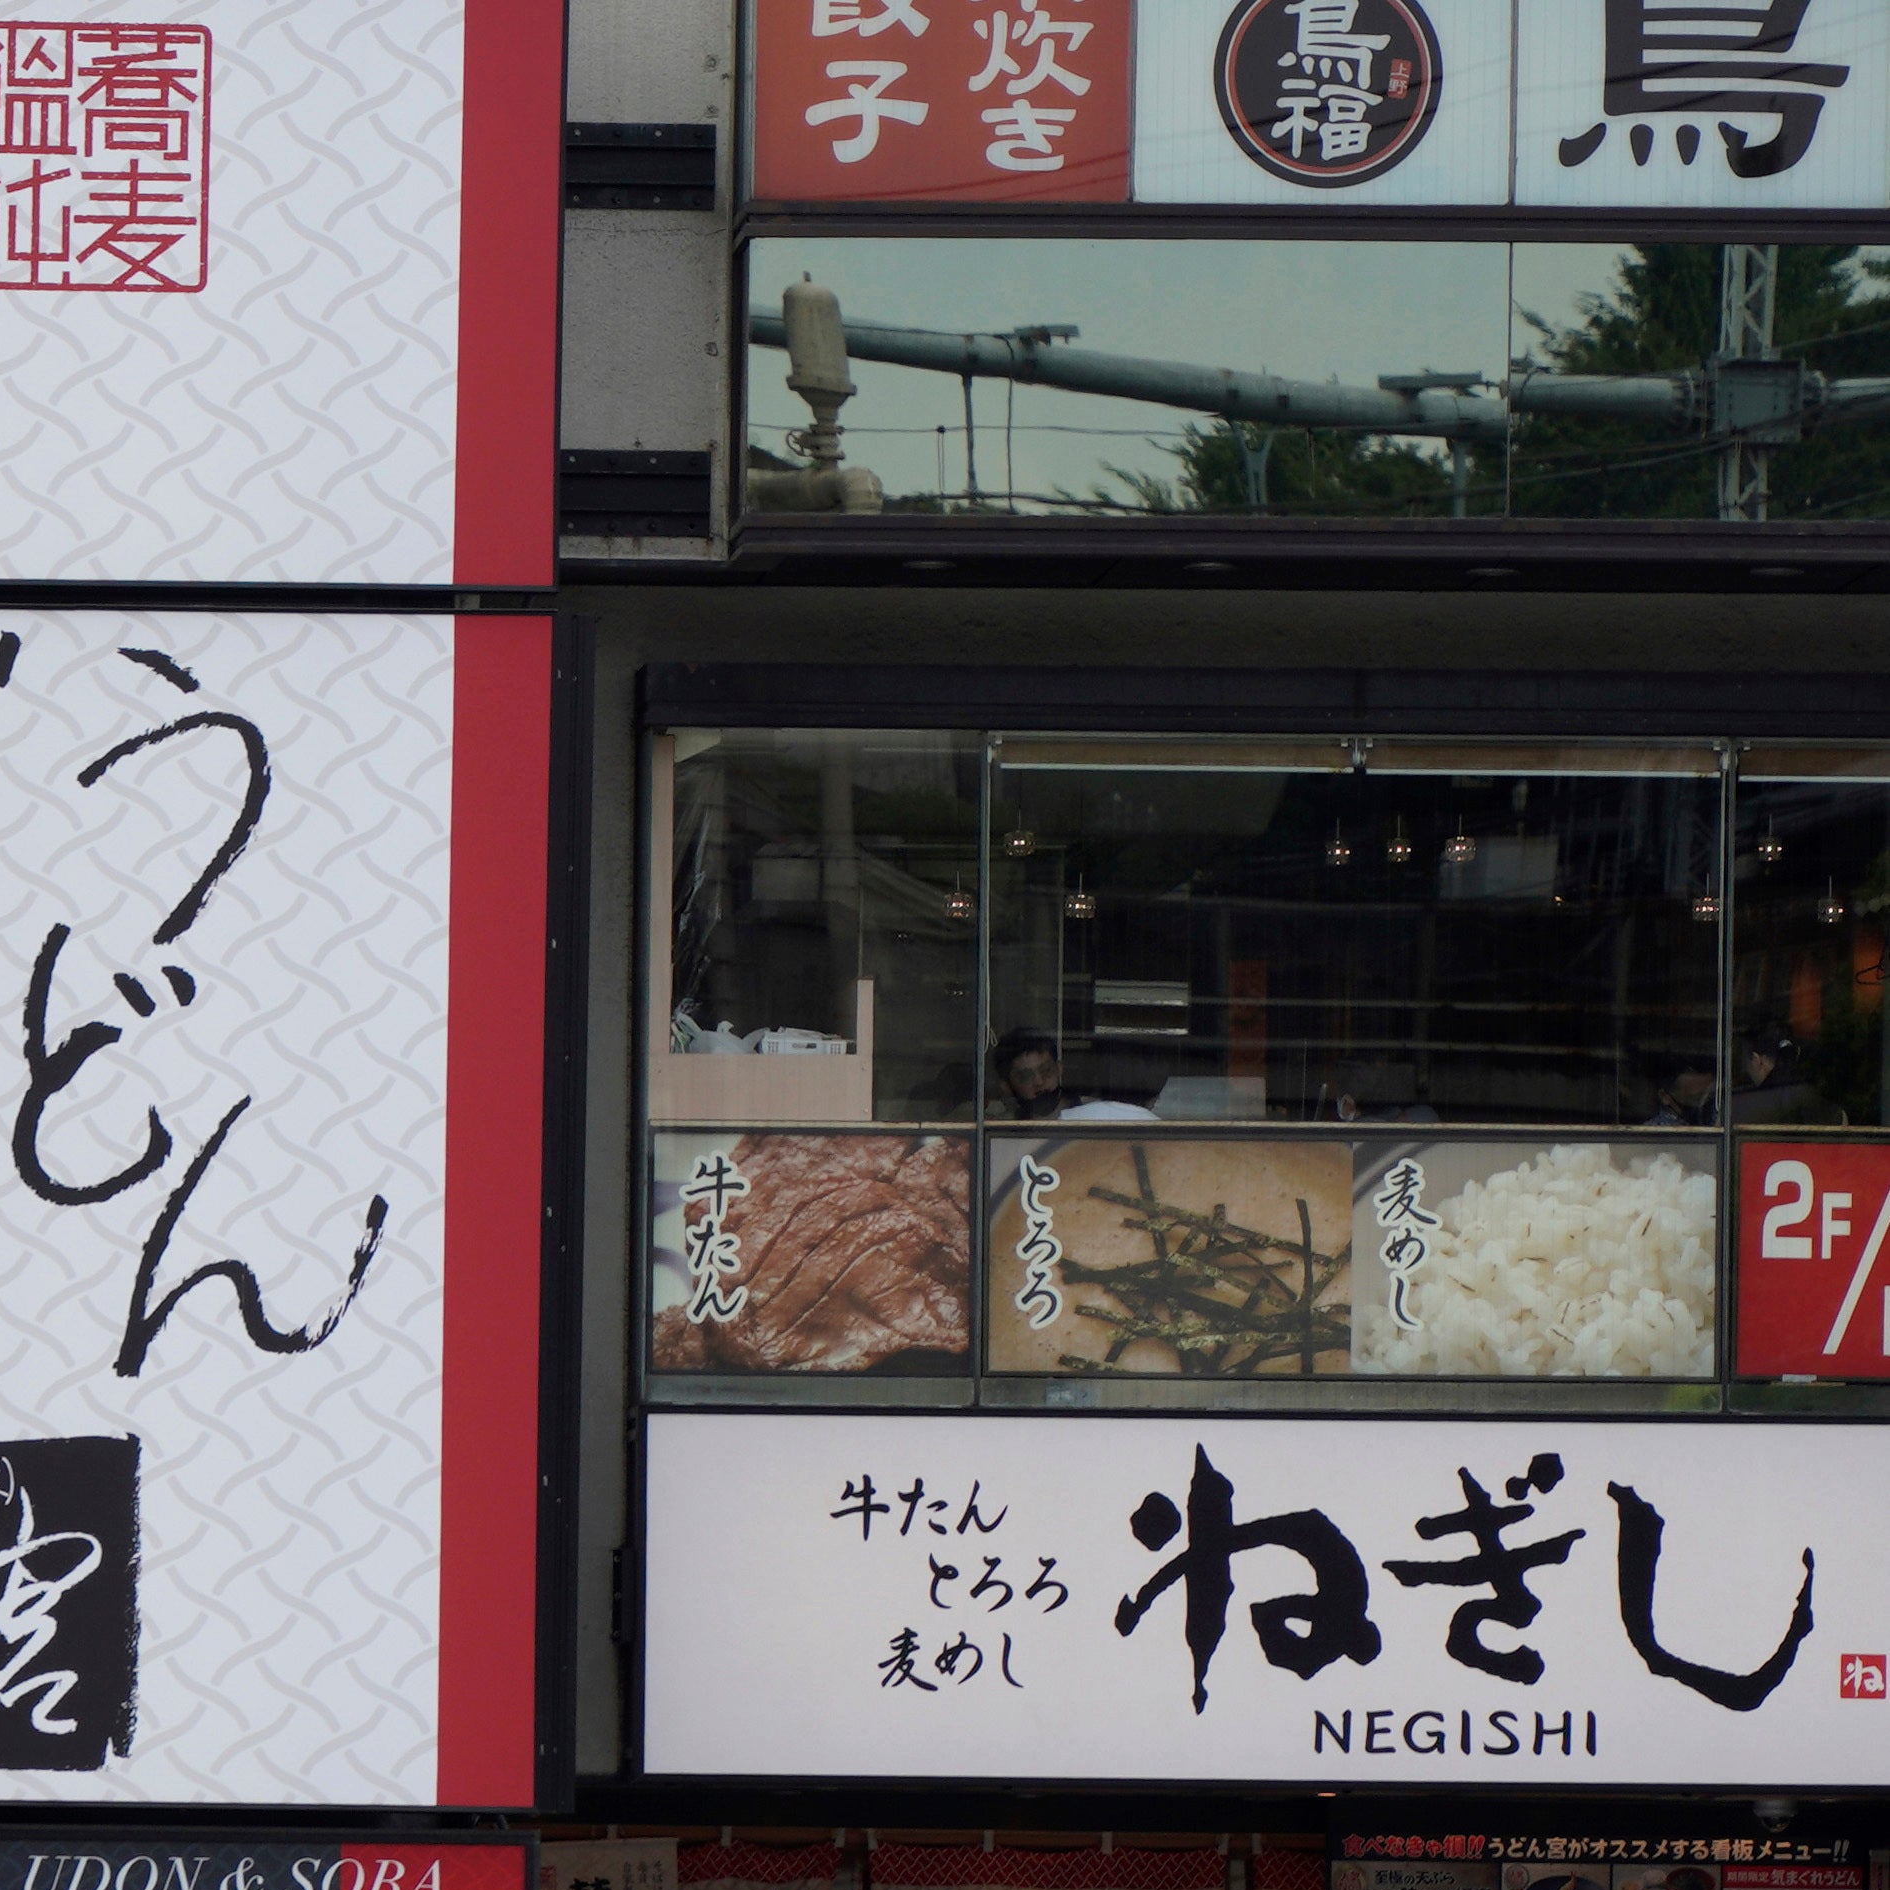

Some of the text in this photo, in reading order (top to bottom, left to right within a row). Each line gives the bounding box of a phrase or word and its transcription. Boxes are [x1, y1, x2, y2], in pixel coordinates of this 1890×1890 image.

[970, 0, 1092, 171] 炊き
[684, 1151, 748, 1325] 牛たん
[1016, 1153, 1063, 1329] とろろ
[1374, 1156, 1443, 1332] 麦めし
[830, 1475, 1008, 1541] 牛たん
[929, 1552, 1070, 1612] とろろ
[1114, 1440, 1814, 1715] ねぎし
[876, 1632, 1026, 1692] 麦めし
[1314, 1710, 1601, 1757] NEGISHI
